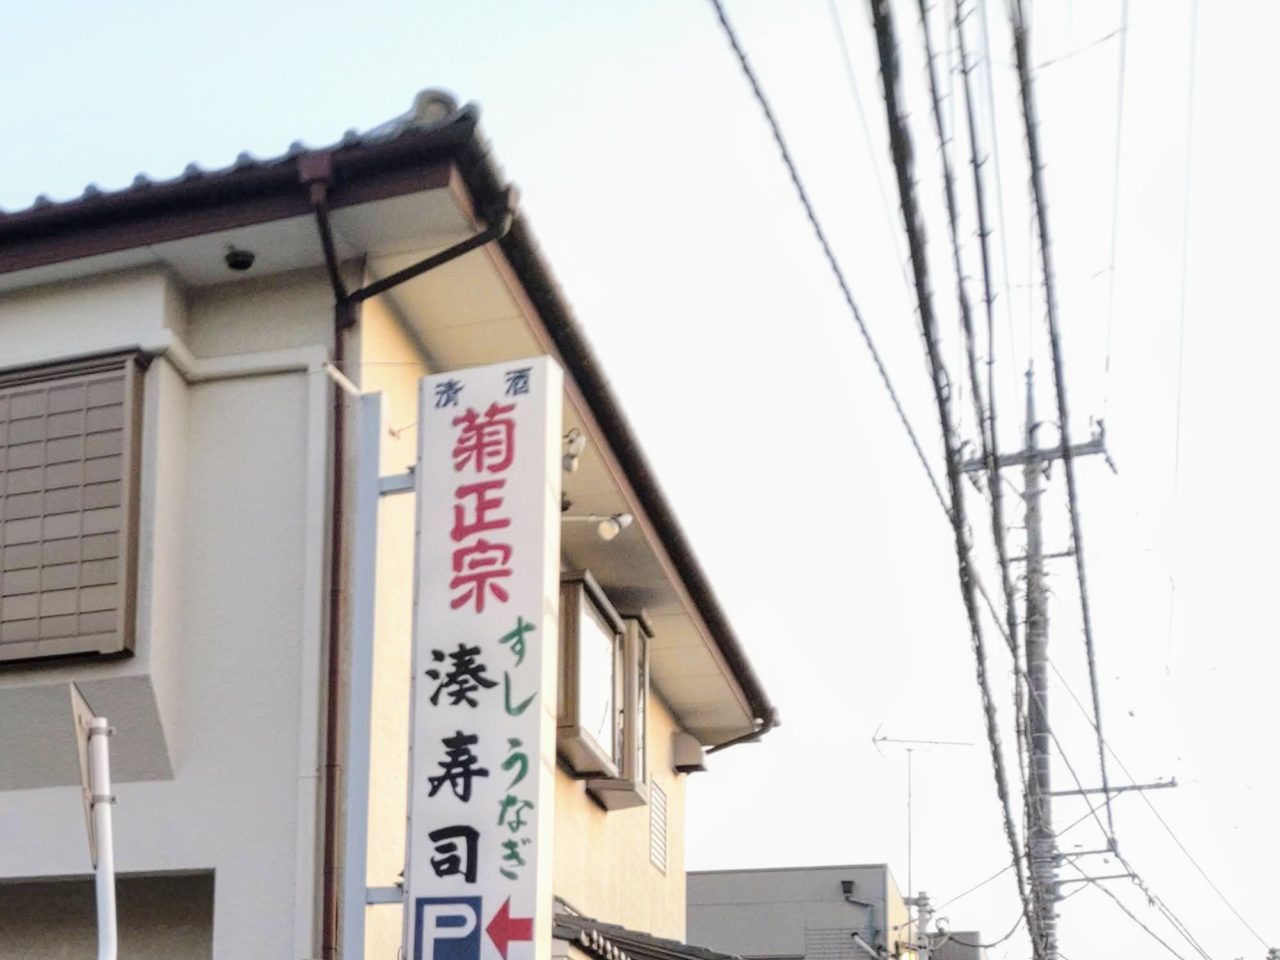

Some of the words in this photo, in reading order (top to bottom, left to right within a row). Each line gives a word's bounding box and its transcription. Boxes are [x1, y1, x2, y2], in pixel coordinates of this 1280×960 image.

[449, 402, 516, 614] 菊正宗
[425, 642, 500, 884] 湊寿司
